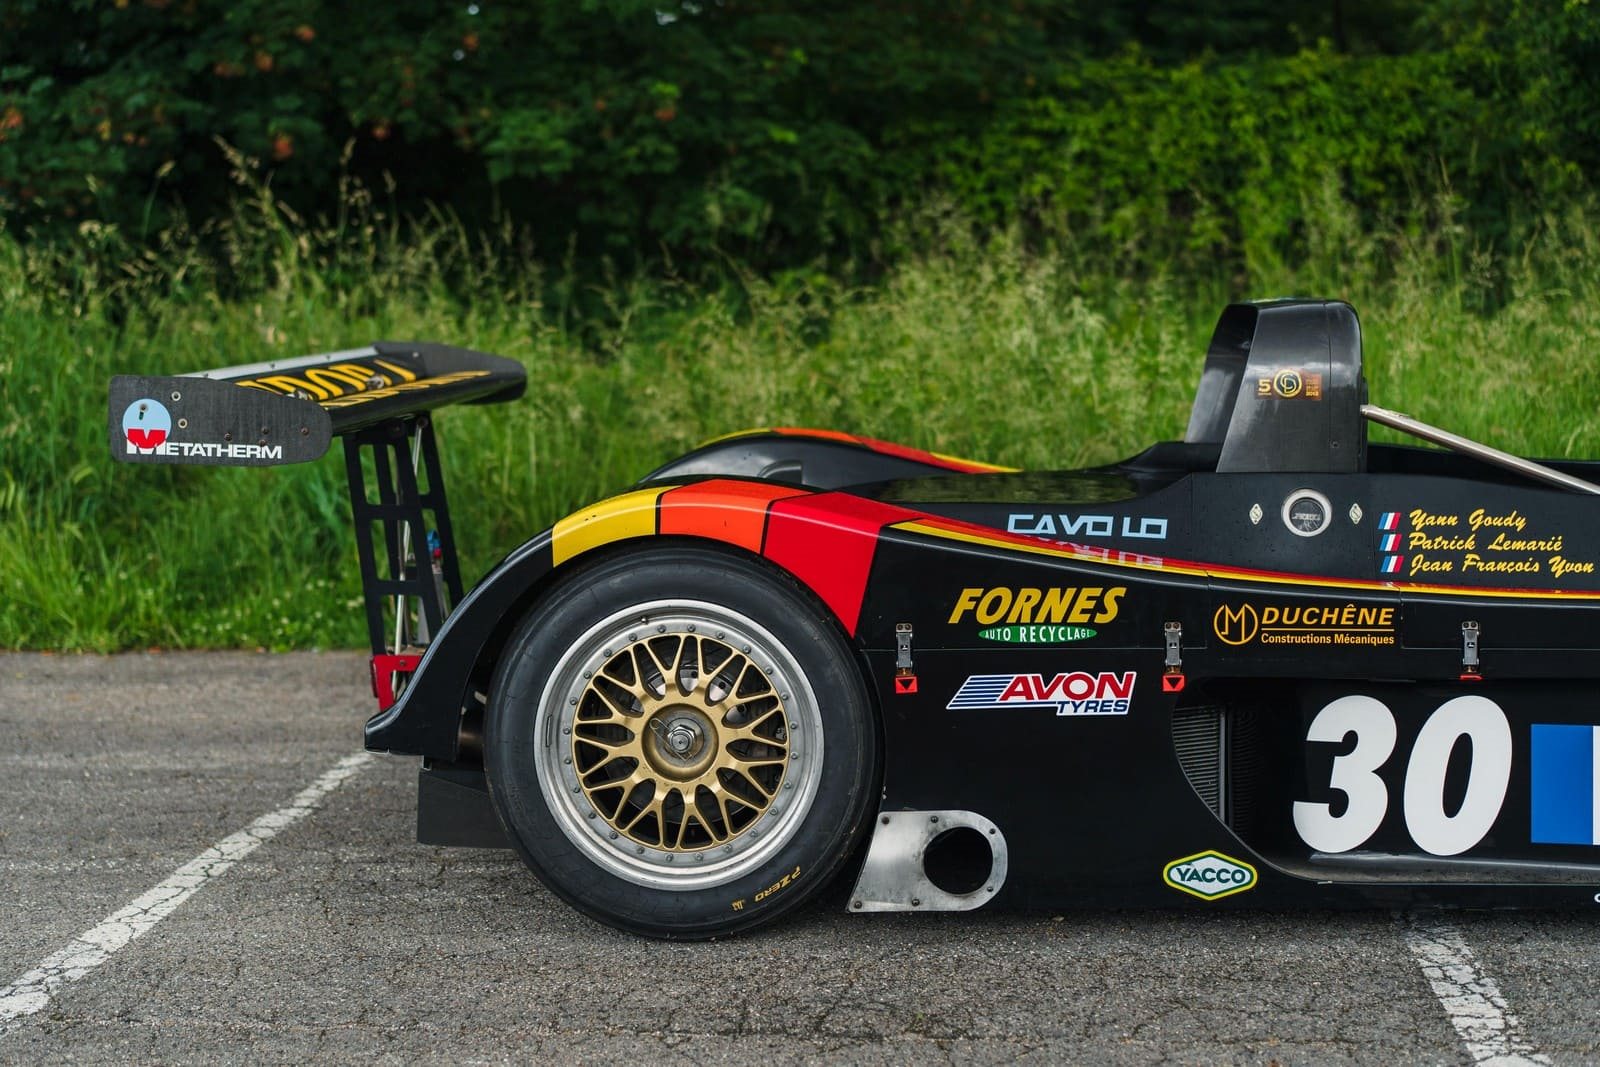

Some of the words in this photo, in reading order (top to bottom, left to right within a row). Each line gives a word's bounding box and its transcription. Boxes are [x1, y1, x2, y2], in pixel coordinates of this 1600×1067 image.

[126, 429, 283, 459] METATHERM
[1409, 509, 1458, 531] Yann
[1468, 508, 1527, 531] Goudy
[1409, 532, 1476, 551] Patrick
[1487, 532, 1563, 551] Lemarié
[1410, 554, 1453, 576] Jean
[1462, 553, 1540, 573] François
[1548, 555, 1595, 578] Yvon
[948, 587, 1127, 625] FORNES
[1261, 604, 1395, 625] DUCHÊNE
[984, 627, 1011, 641] AUTO
[1019, 626, 1090, 642] RECYCLAGE
[1261, 634, 1331, 644] Constructions
[1334, 634, 1395, 646] Mécaniques
[999, 673, 1135, 701] AVON
[1056, 700, 1128, 713] TYRES
[1293, 695, 1512, 856] 30
[1176, 867, 1246, 884] YACCO
